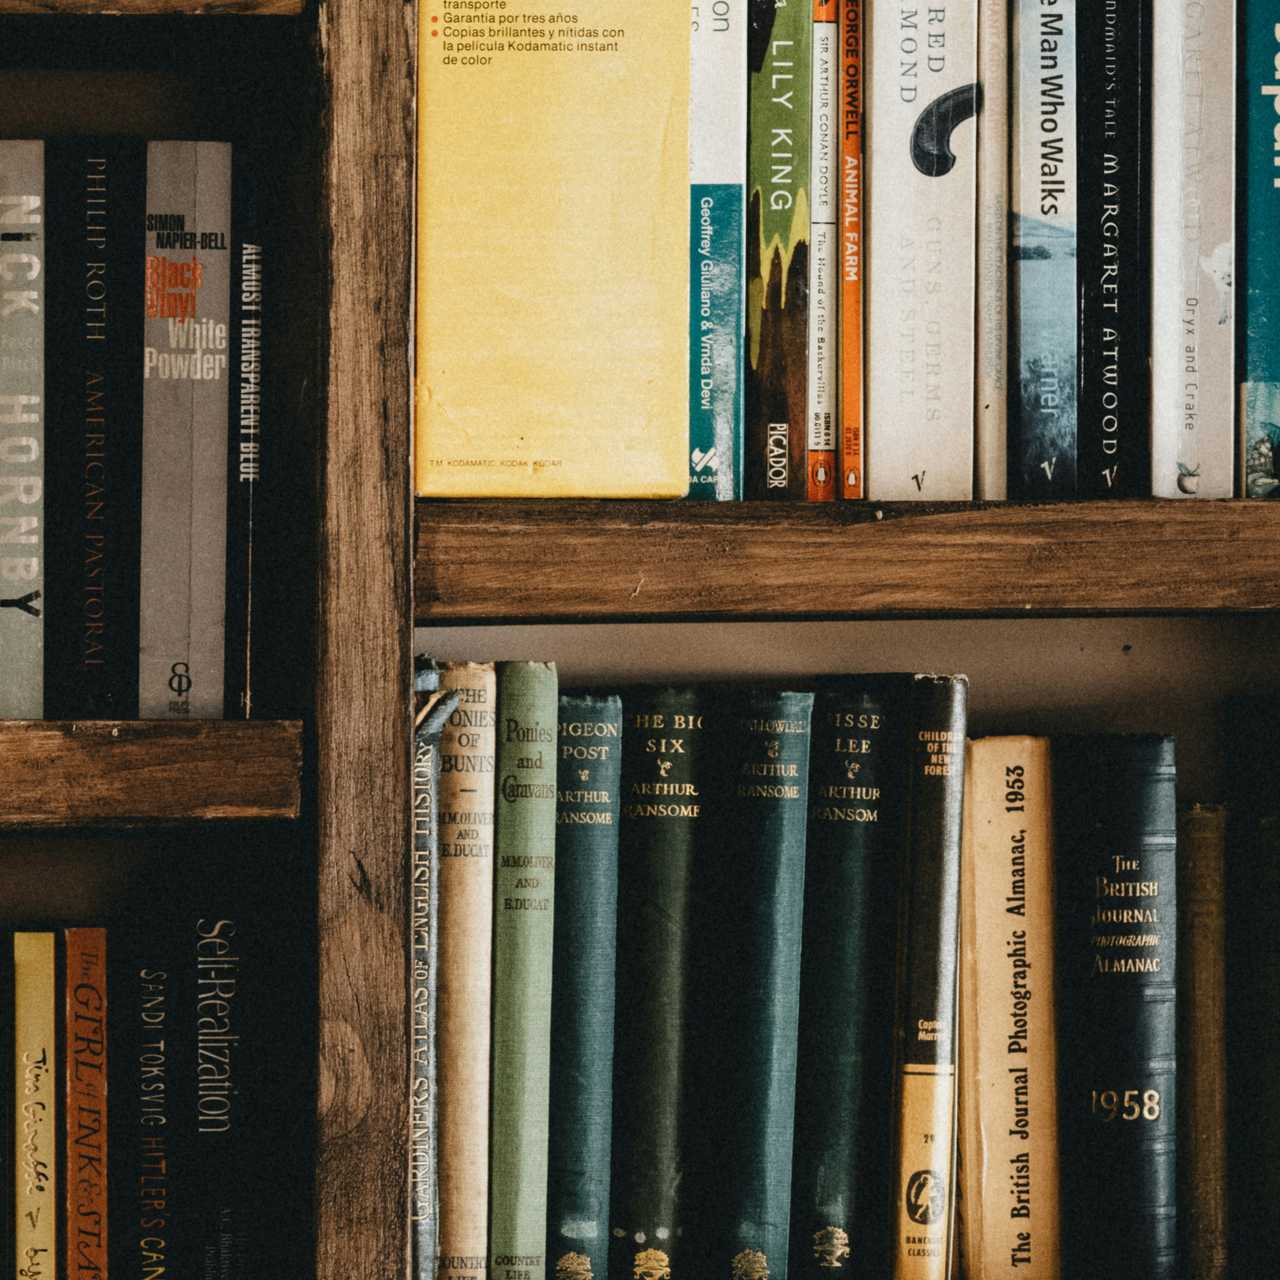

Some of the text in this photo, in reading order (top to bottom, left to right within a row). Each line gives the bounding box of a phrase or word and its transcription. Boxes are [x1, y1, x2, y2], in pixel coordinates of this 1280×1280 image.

[771, 40, 792, 210] LILY KING
[1041, 13, 1063, 215] Man Who Walks
[699, 197, 712, 255] Geoffrey
[845, 157, 858, 280] ANIMAL FARM
[700, 260, 712, 317] Giuliano
[701, 321, 712, 330] &
[1103, 153, 1118, 454] MARGARET ATWOOD
[701, 379, 713, 409] Devi
[1182, 297, 1198, 431] Oryx and Crake
[769, 425, 786, 488] PICADOR
[1005, 765, 1031, 1267] The British Journal Photographic Almanac, 1953
[1091, 1088, 1160, 1122] 1958
